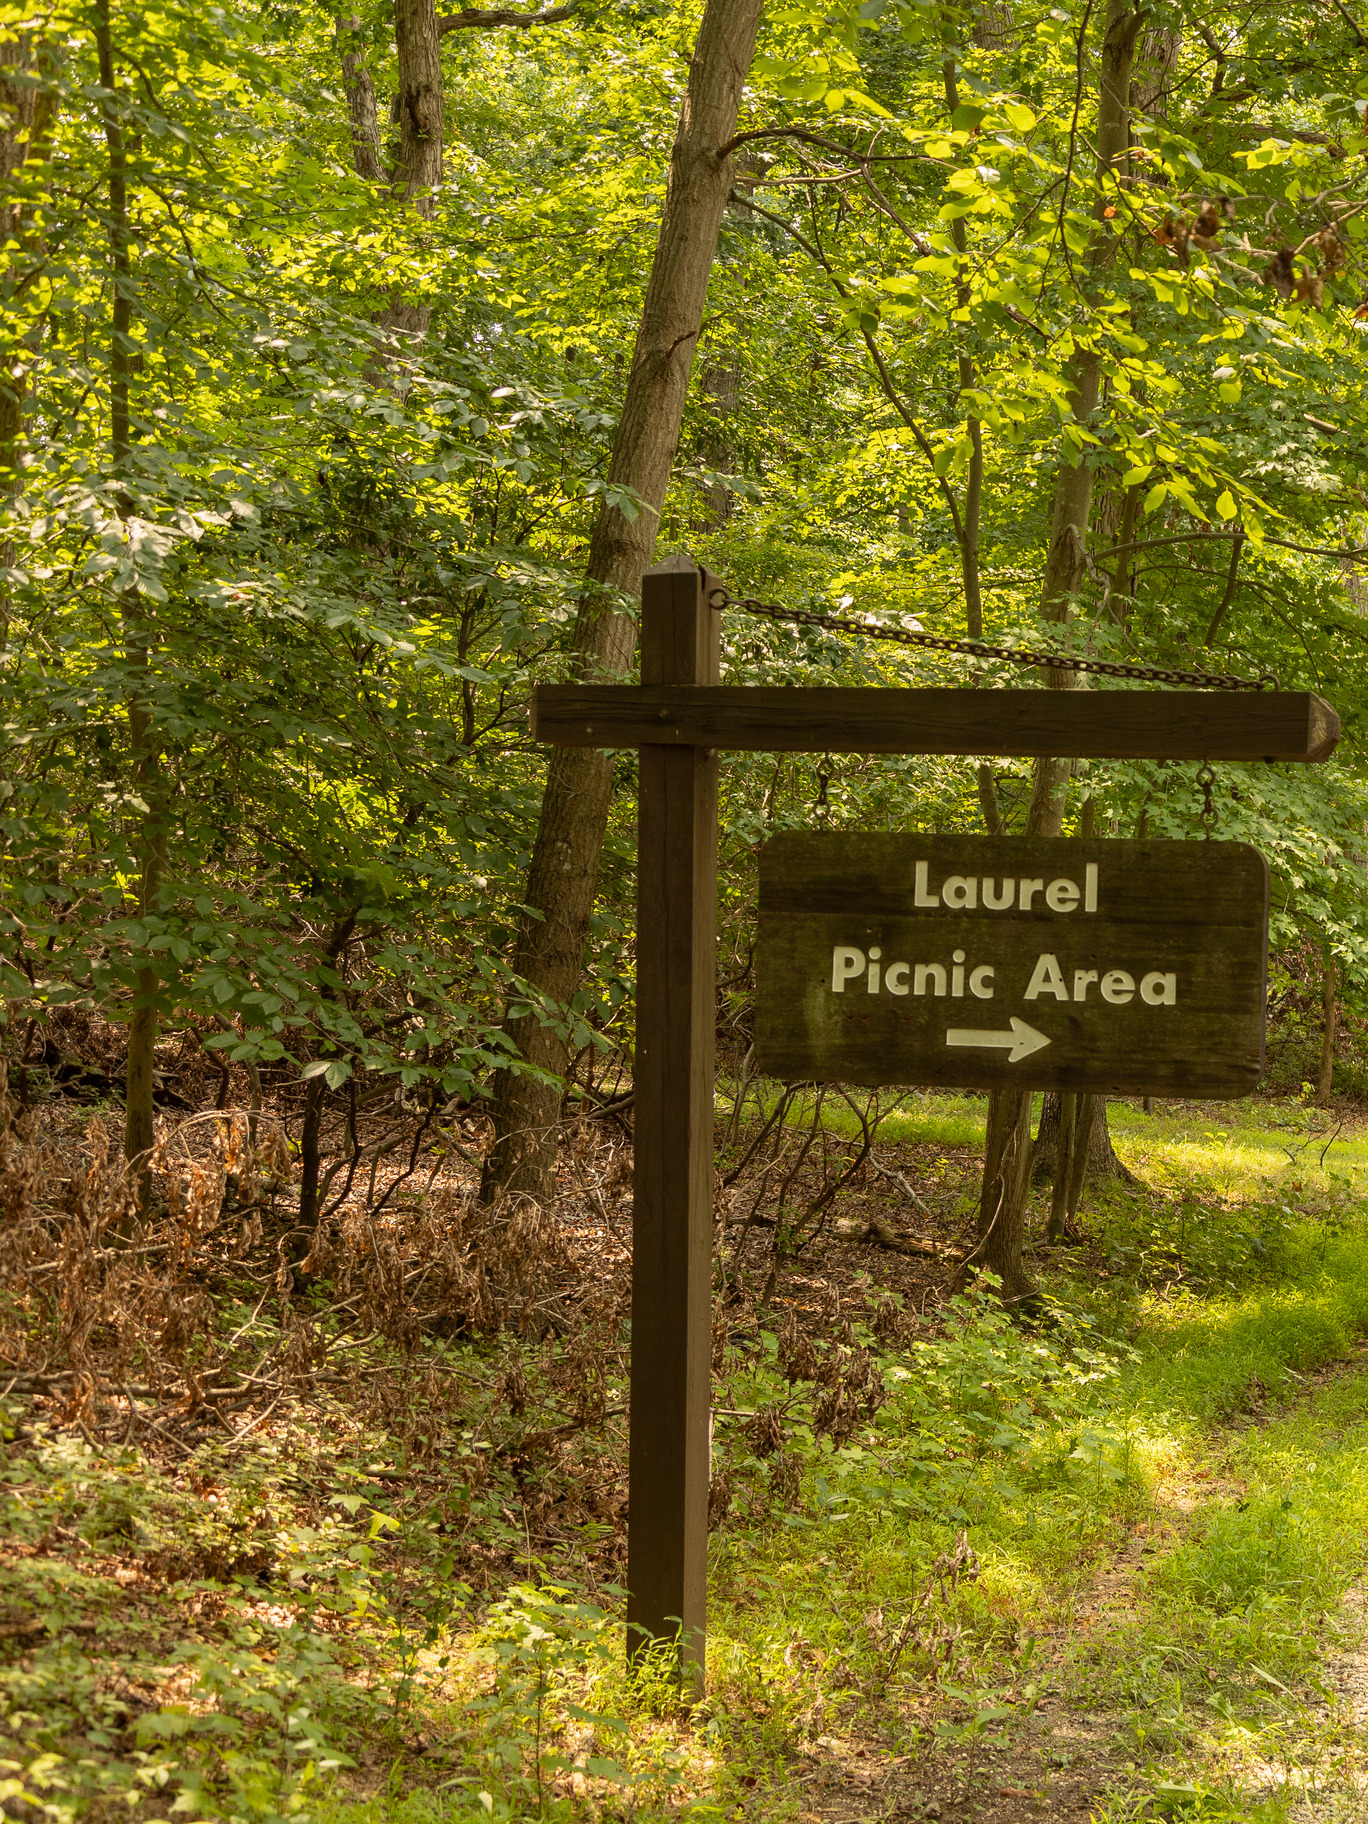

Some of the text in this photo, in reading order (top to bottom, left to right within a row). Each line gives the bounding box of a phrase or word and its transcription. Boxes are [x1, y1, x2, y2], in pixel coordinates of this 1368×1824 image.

[914, 861, 1098, 913] Laurel
[831, 946, 1177, 1006] Picnic Area
